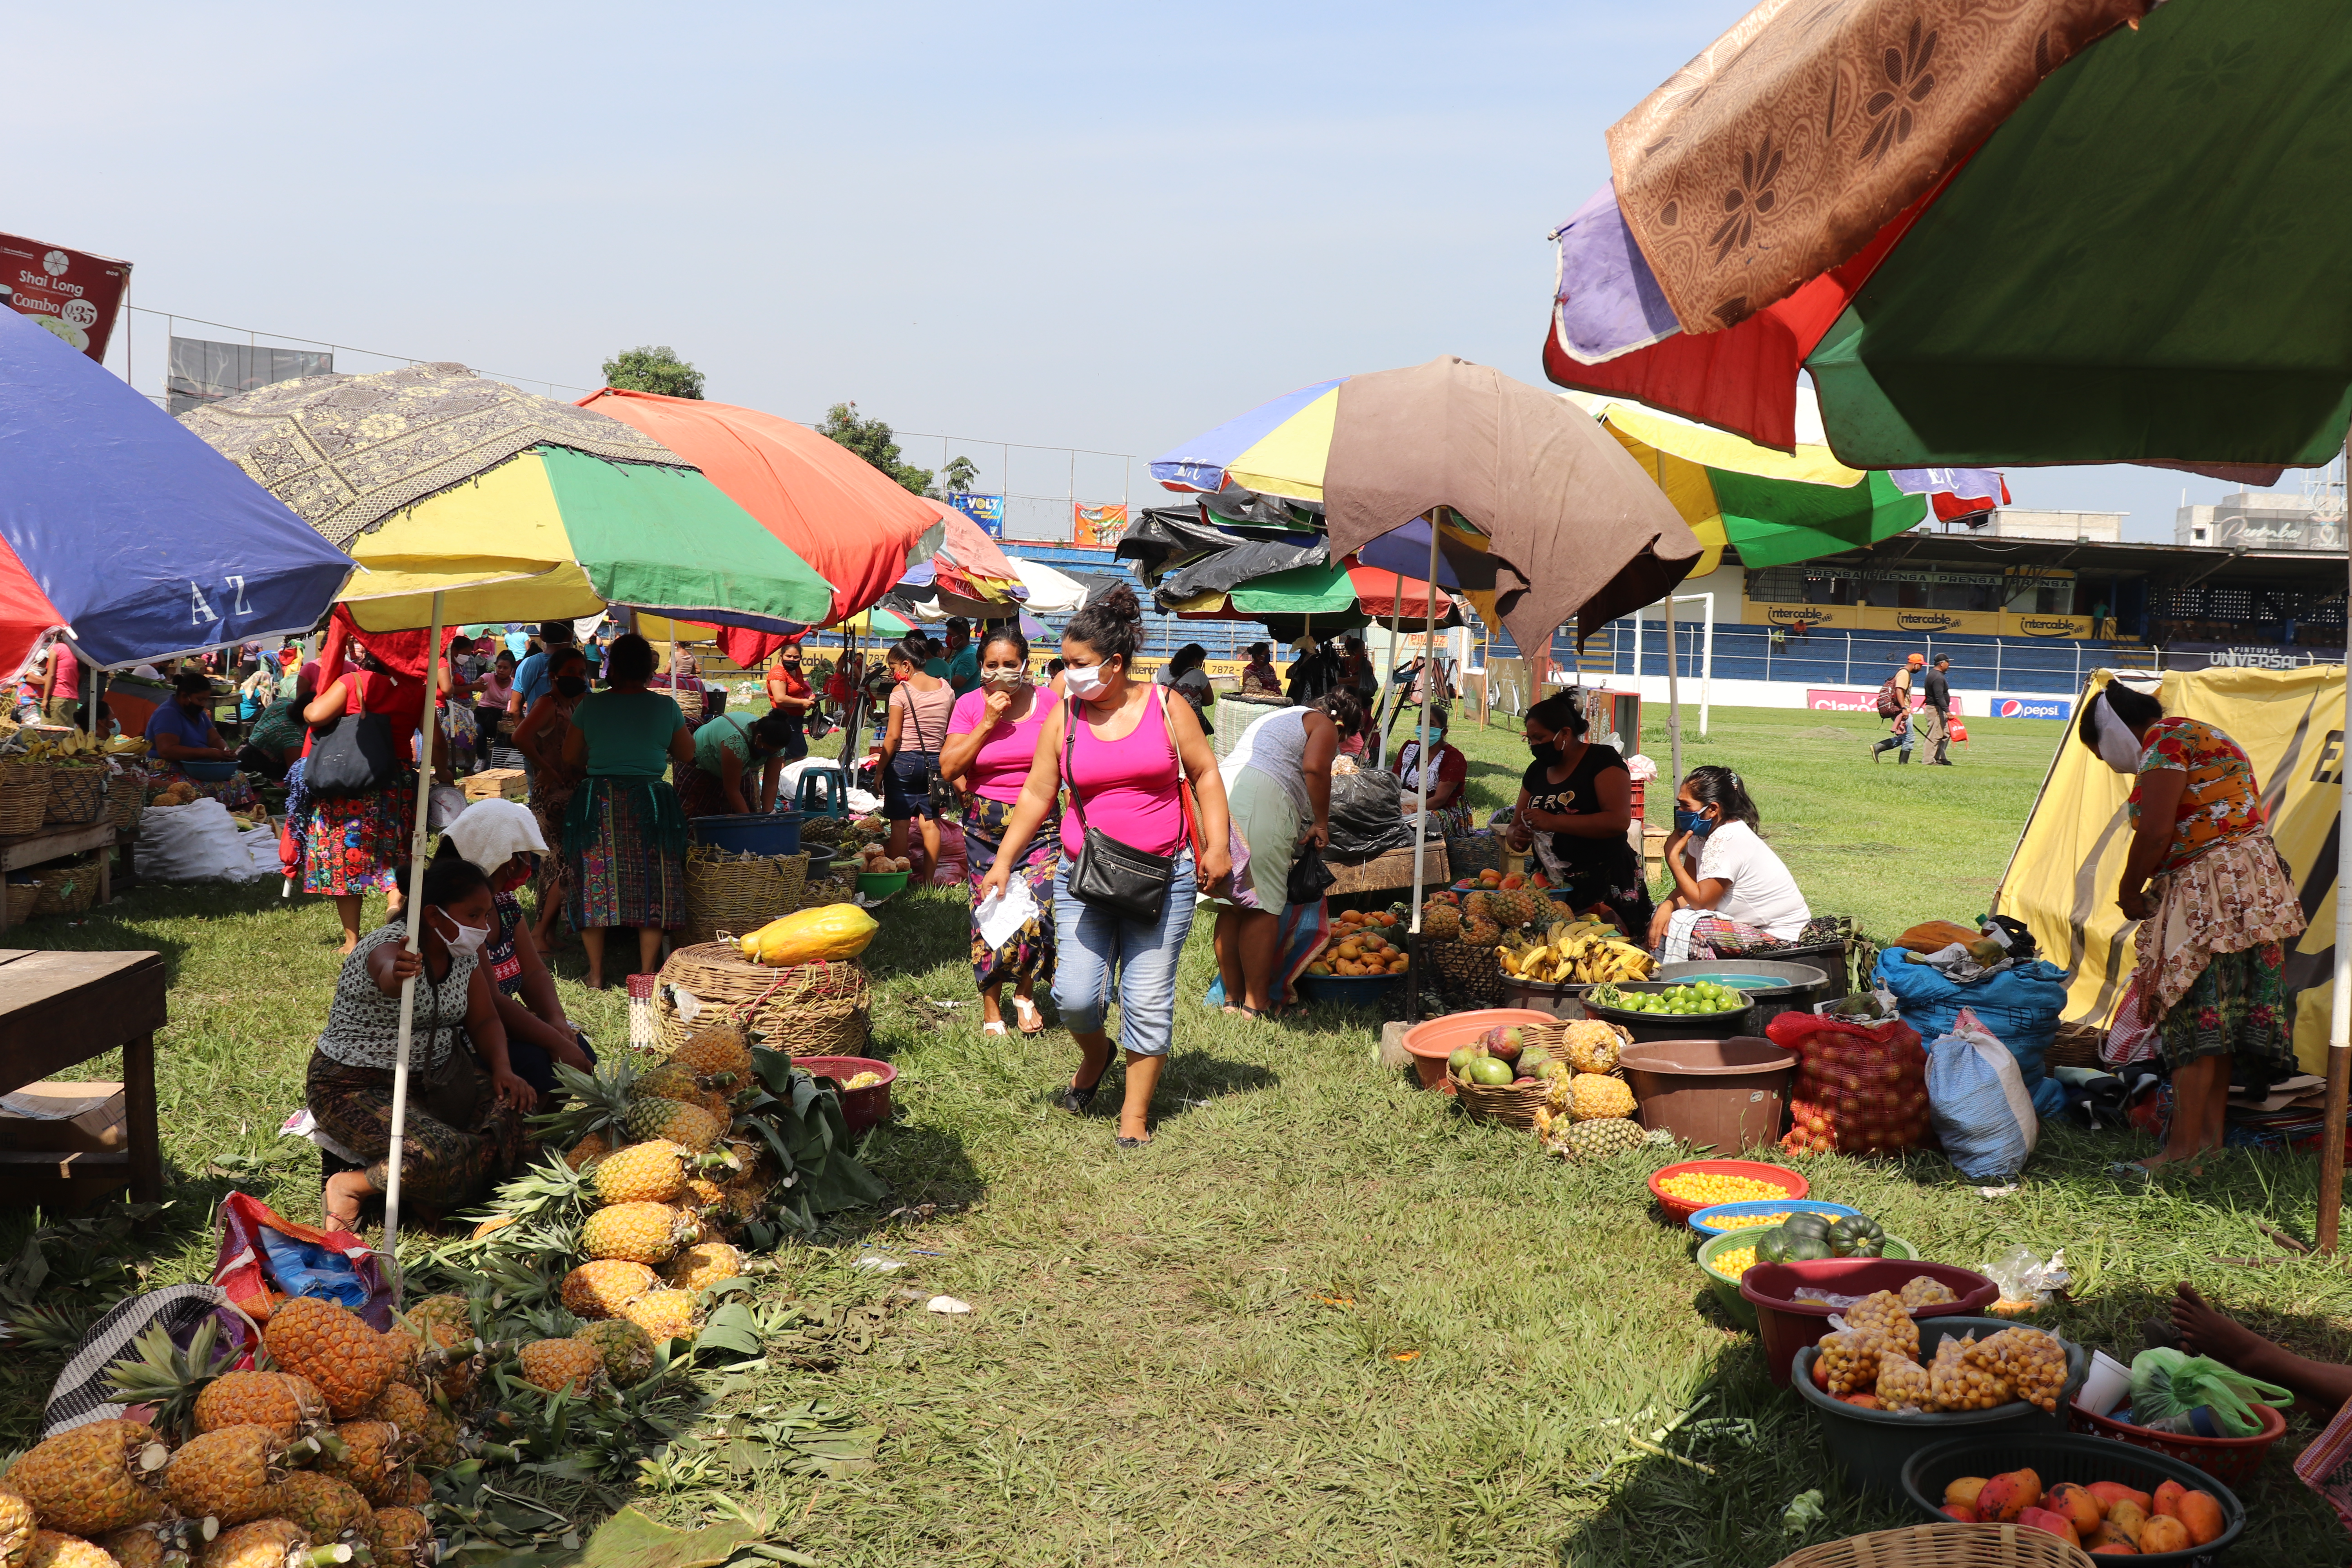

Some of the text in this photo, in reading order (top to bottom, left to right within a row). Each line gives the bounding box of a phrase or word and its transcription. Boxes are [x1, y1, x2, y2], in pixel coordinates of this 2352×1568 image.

[19, 270, 48, 287] Shai
[52, 278, 83, 297] Long
[13, 292, 60, 313] Combo
[967, 497, 1000, 510] VOLT
[2217, 515, 2302, 542] Rumba
[1804, 570, 1860, 579] PRENSA
[1940, 575, 1996, 584] PRENSA
[1768, 606, 1822, 620] intercable
[1897, 612, 1951, 625] intercable
[2021, 617, 2074, 630] intercable
[2210, 652, 2301, 669] UNIVERSAL
[2024, 706, 2059, 717] pepsi
